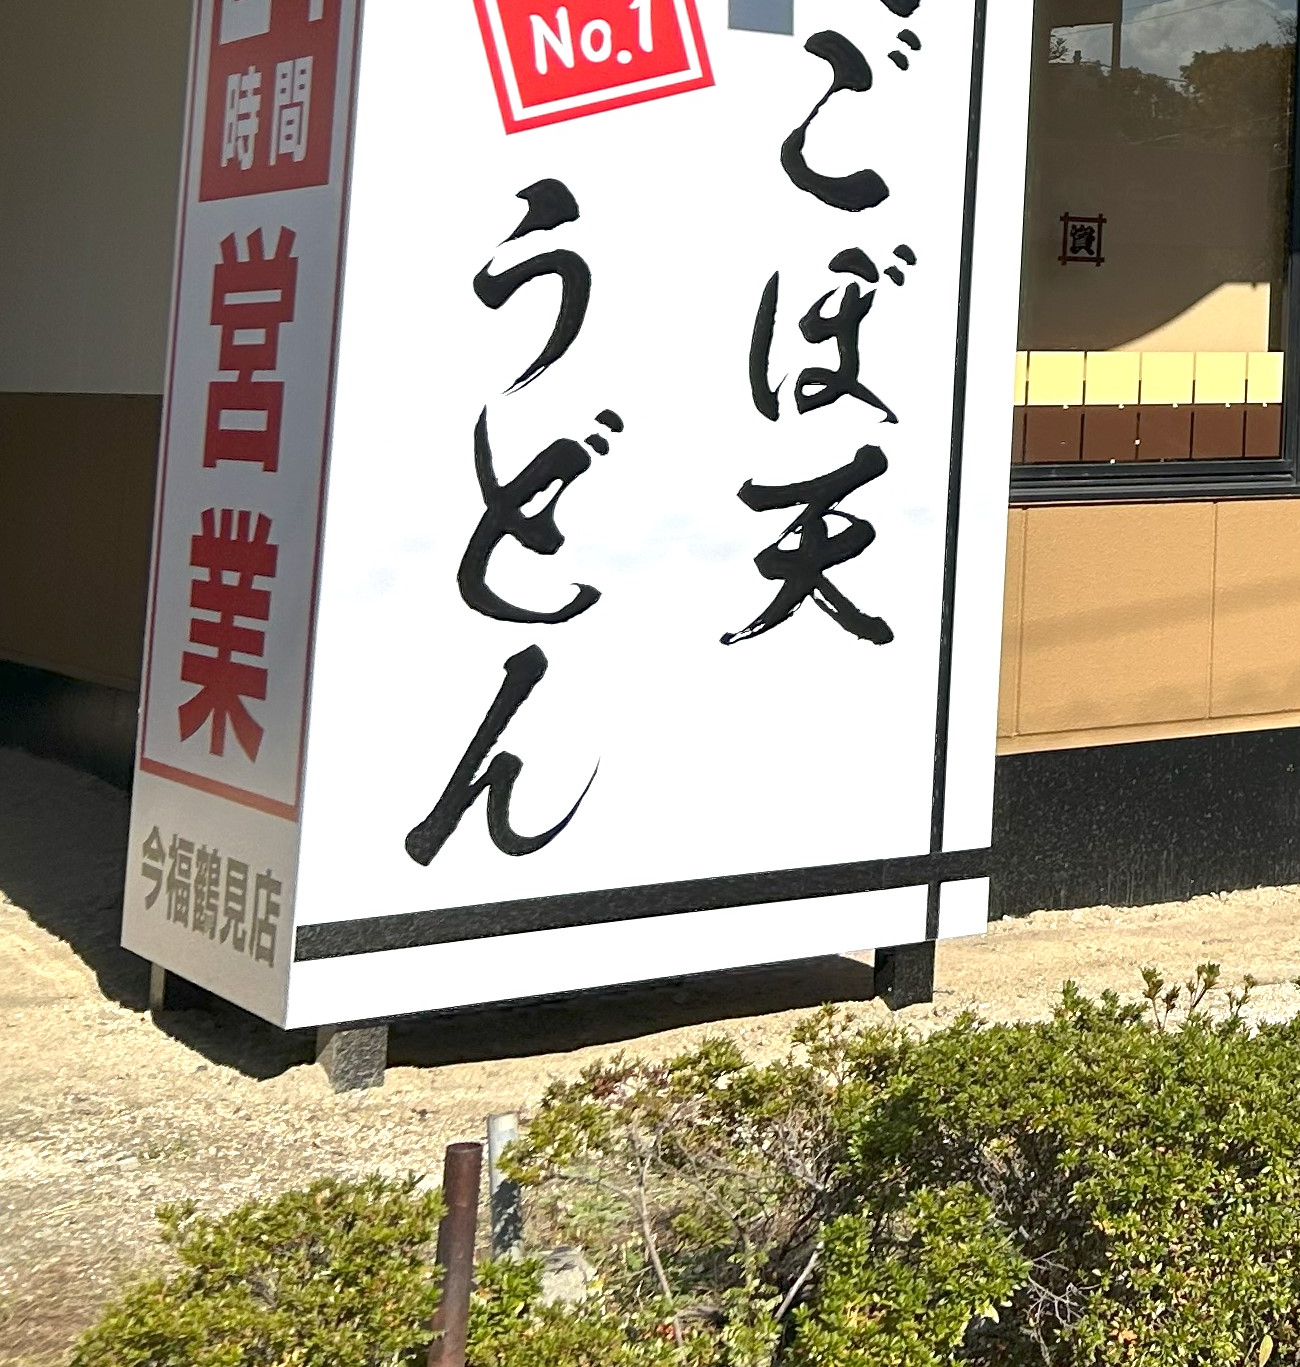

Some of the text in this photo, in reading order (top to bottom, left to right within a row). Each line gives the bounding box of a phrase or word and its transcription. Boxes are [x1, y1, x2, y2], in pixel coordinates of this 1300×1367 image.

[220, 56, 314, 170] 時間
[179, 225, 299, 764] 営業
[405, 178, 625, 867] うどん
[140, 822, 283, 970] 今福鶴見店
